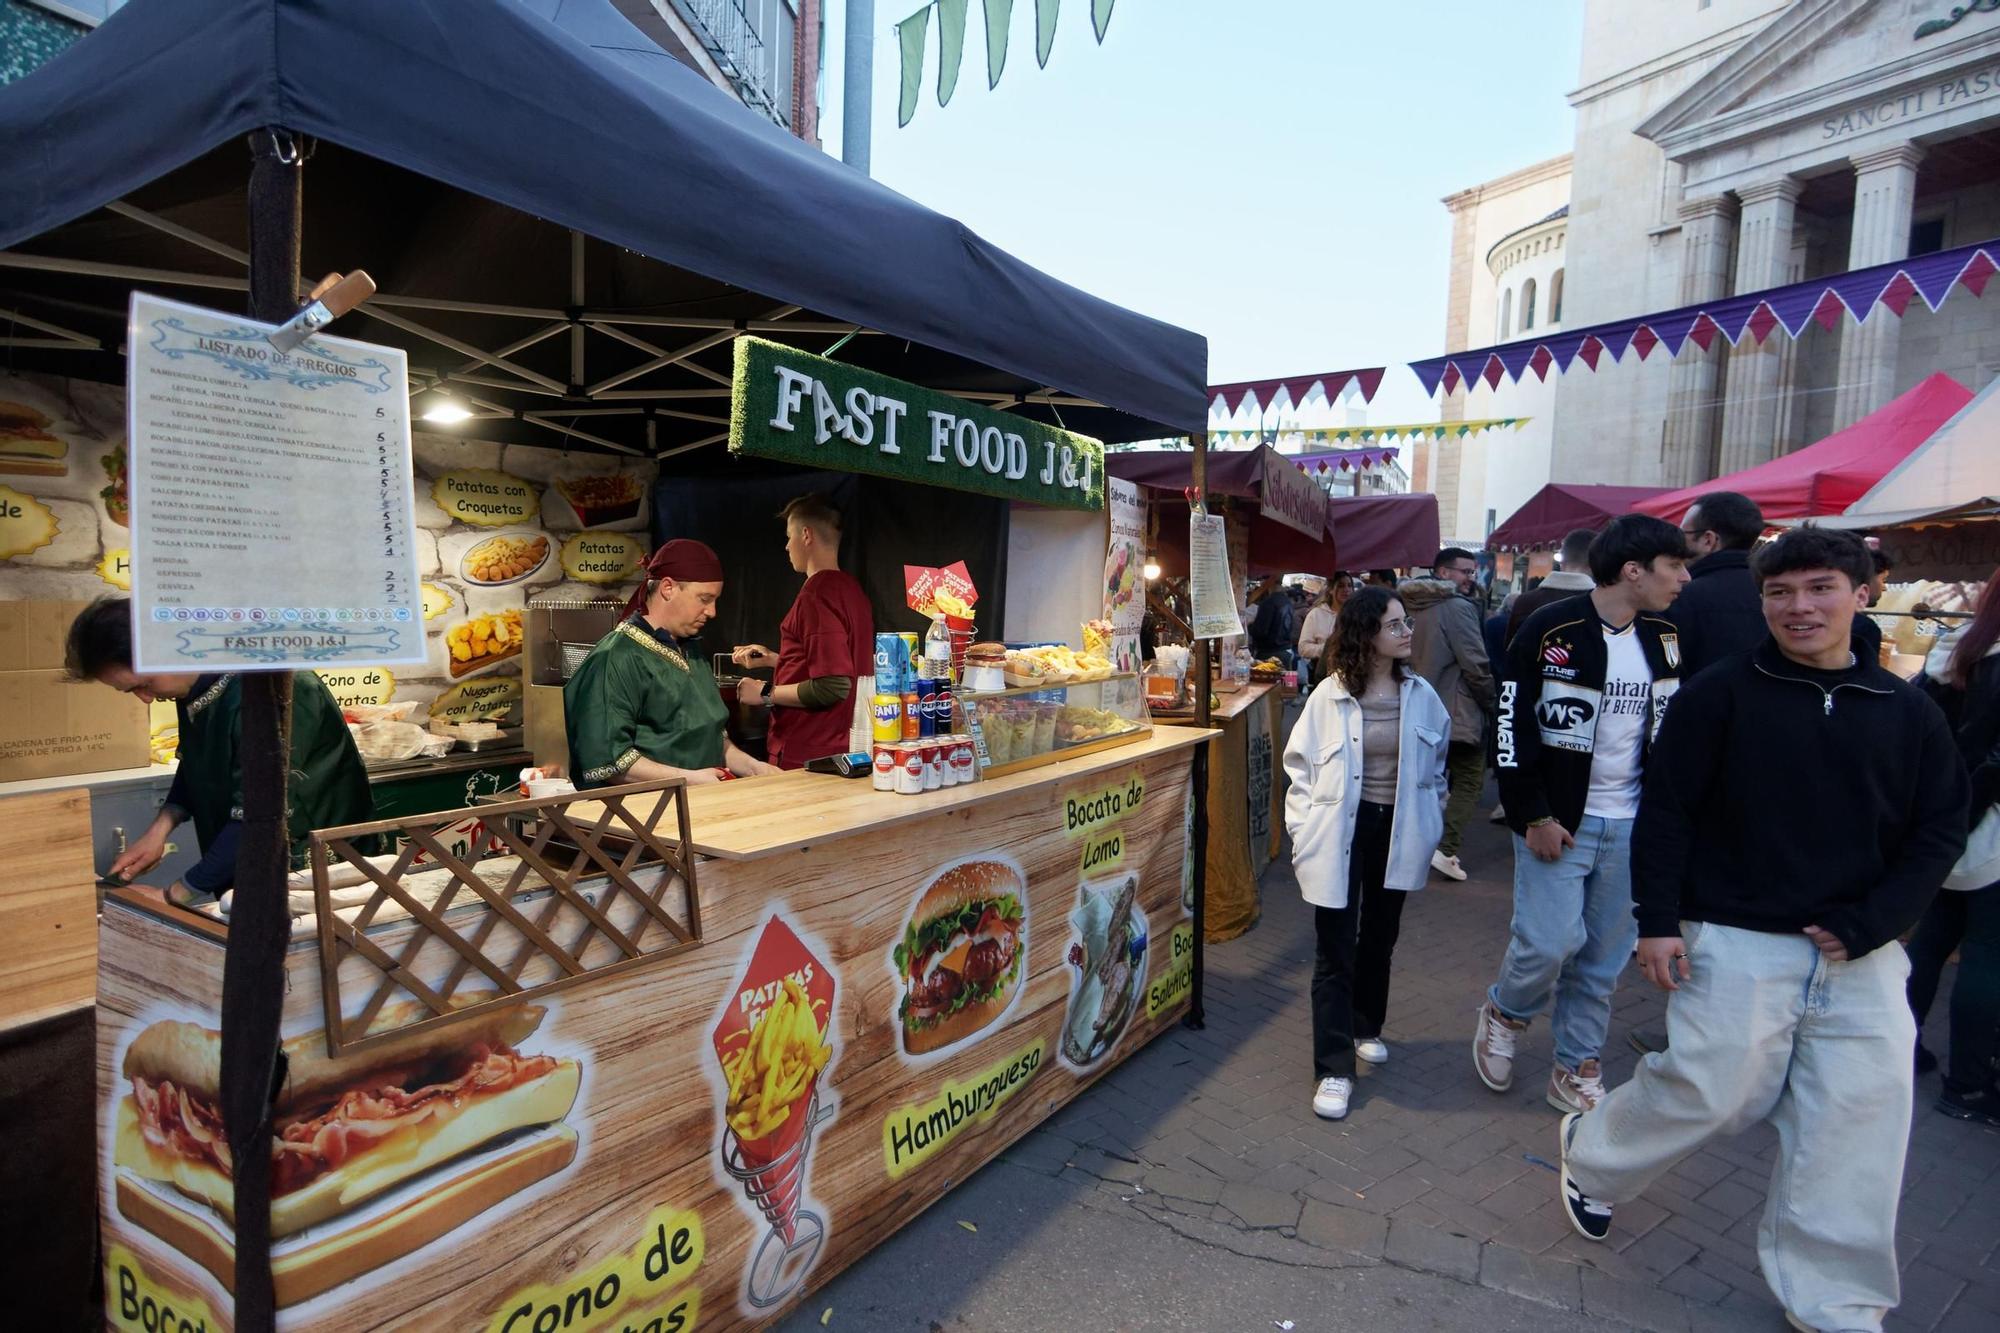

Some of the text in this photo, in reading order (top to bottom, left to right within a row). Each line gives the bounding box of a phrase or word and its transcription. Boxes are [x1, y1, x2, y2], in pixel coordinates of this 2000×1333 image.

[1822, 91, 1926, 140] SANCTI
[199, 337, 268, 360] LISTADO
[272, 353, 291, 366] DE
[376, 408, 385, 418] 5
[769, 364, 908, 455] FAST
[927, 410, 1028, 480] FOOD
[447, 478, 526, 497] Patatas con
[456, 500, 523, 517] Croquetas
[579, 541, 625, 555] Patatas
[578, 560, 624, 573] cheddar
[385, 570, 396, 581] 2
[386, 584, 395, 592] 2
[224, 635, 347, 649] FAST FOOD J&J
[320, 672, 381, 687] Cono de
[460, 682, 509, 700] Nuggets
[446, 705, 466, 716] con
[1541, 702, 1585, 729] WS
[1497, 680, 1518, 768] Forward
[4, 738, 44, 750] CADENA
[45, 737, 58, 746] DE
[61, 735, 82, 743] FRIO
[36, 747, 49, 756] DE
[53, 745, 74, 754] FRIO
[1067, 779, 1143, 830] Bocata de
[1083, 837, 1120, 870] Lomo
[891, 1048, 1041, 1165] Hamburguesa
[644, 1223, 693, 1282] de
